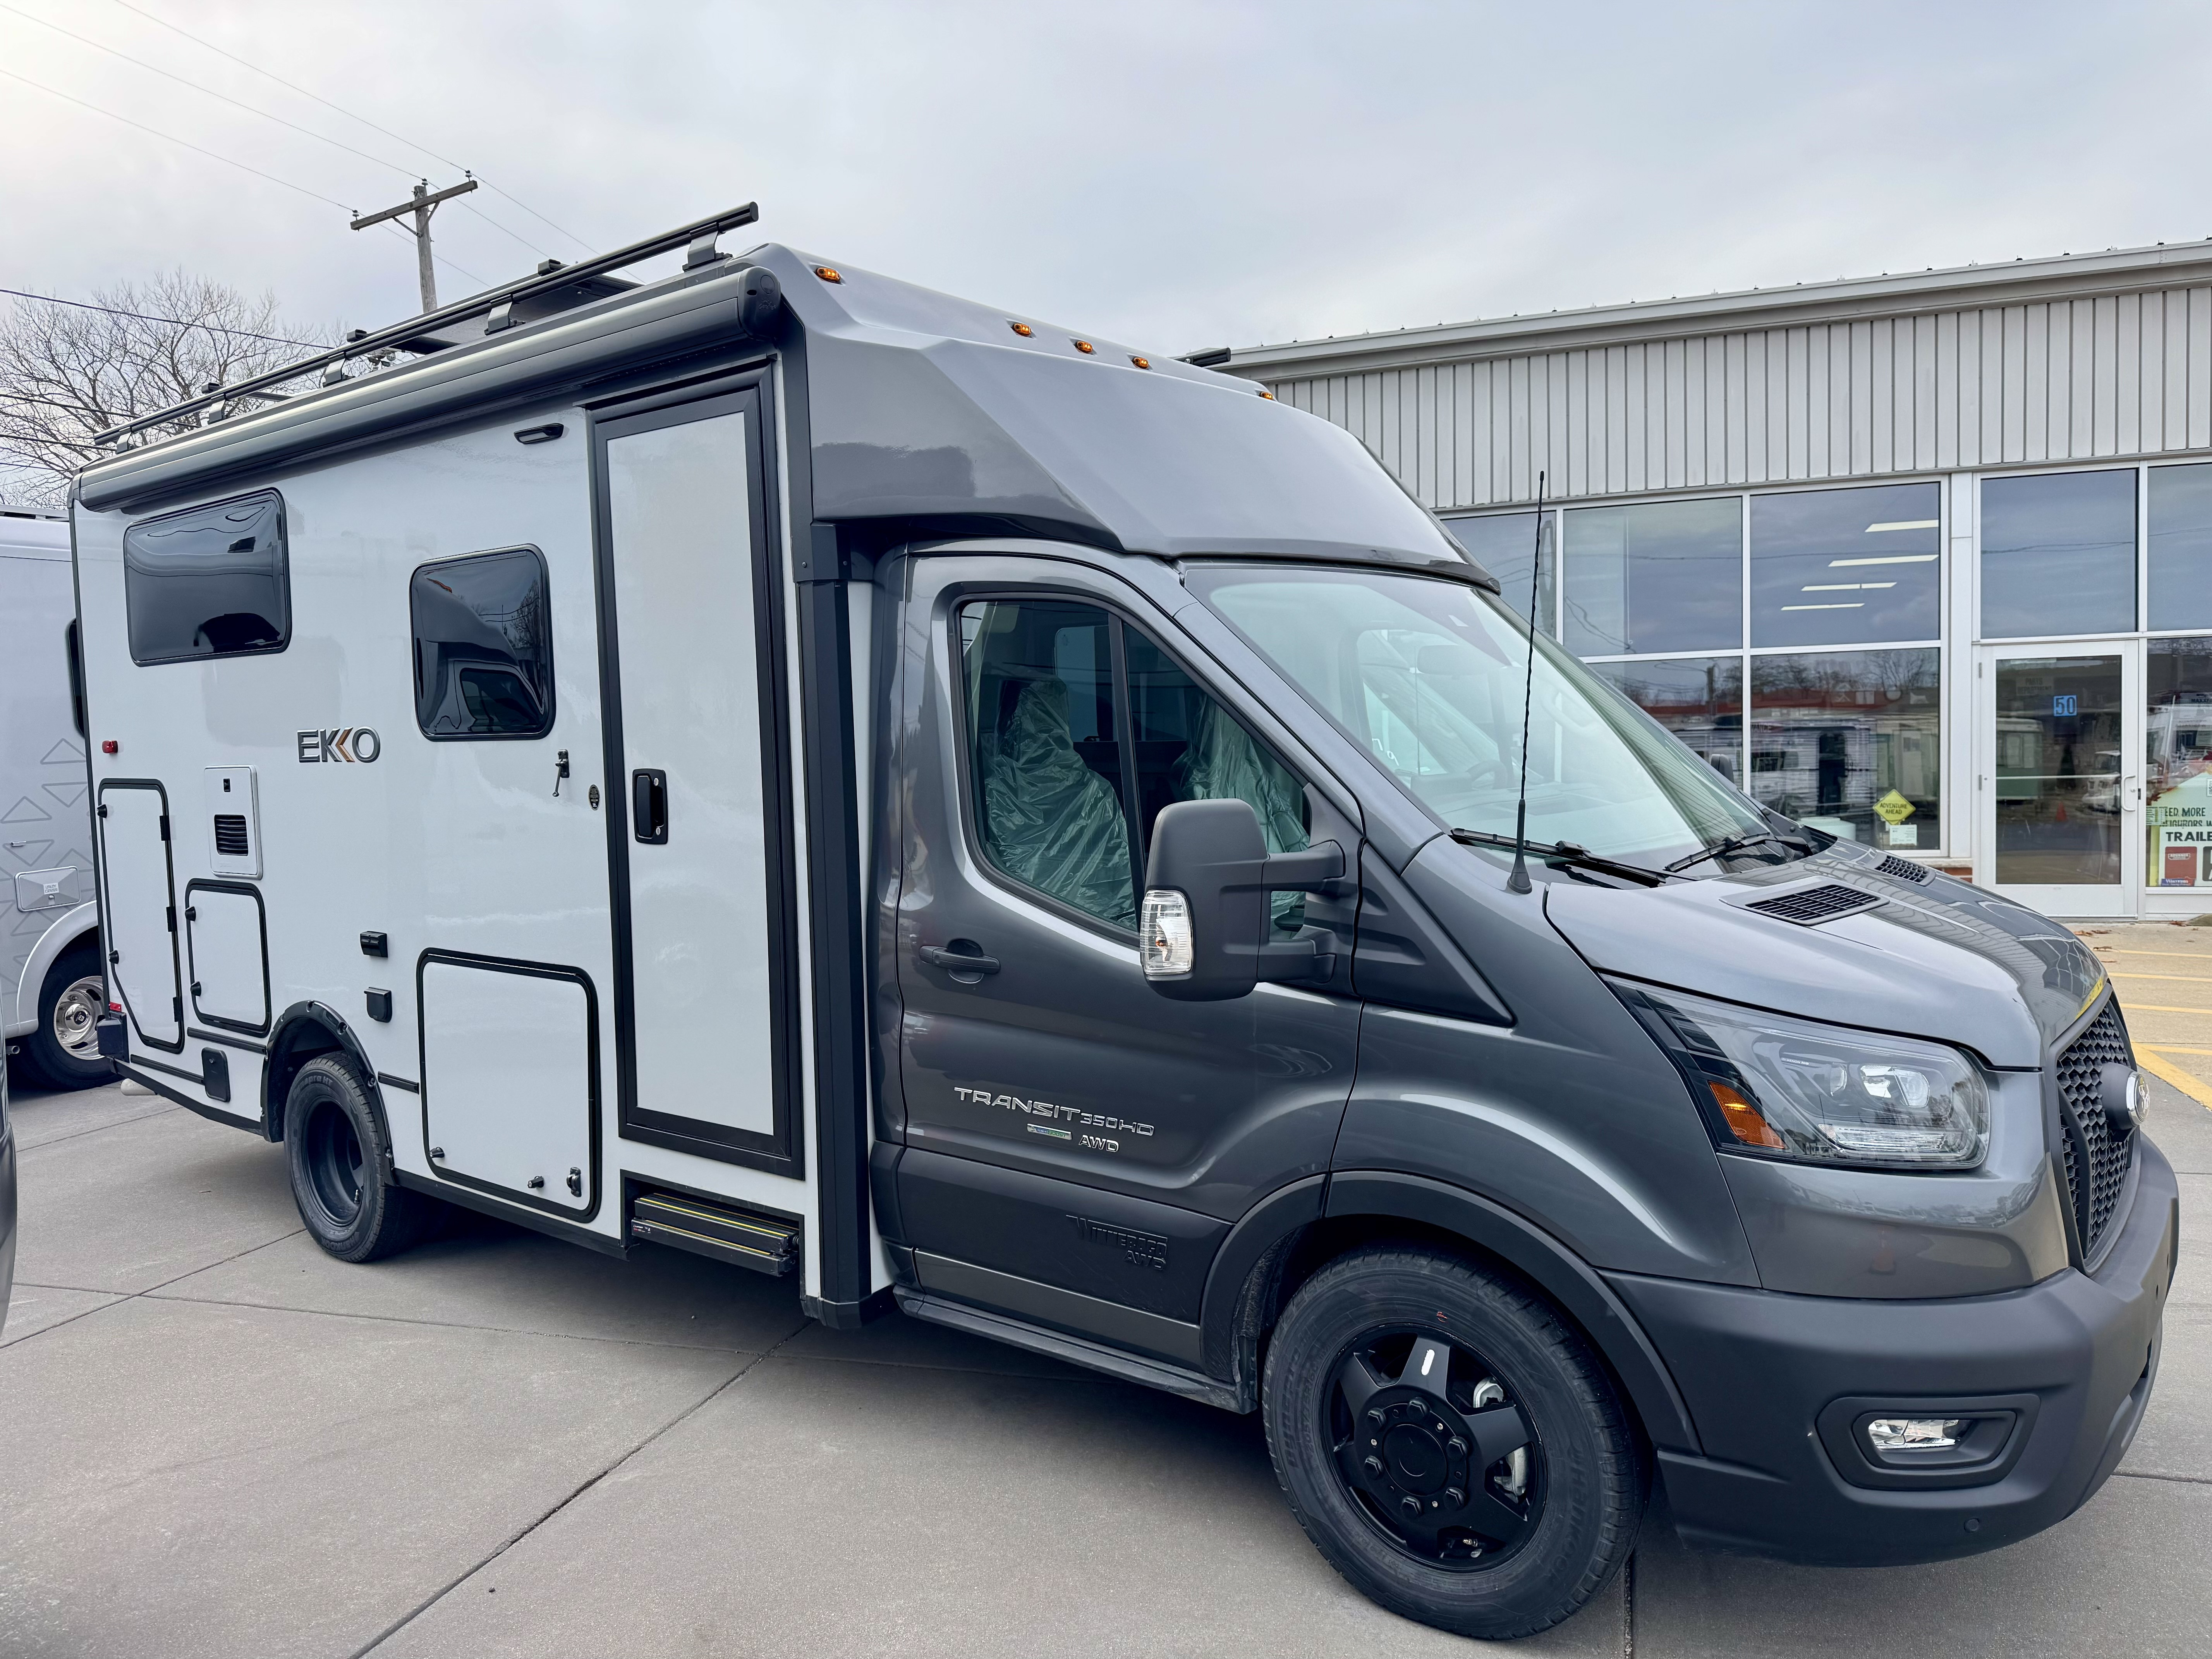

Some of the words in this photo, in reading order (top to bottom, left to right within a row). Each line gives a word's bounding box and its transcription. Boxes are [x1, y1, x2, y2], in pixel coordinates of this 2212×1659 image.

[2056, 697, 2076, 714] 50
[297, 726, 381, 763] EKKO
[2182, 807, 2205, 817] MORE
[954, 1087, 1080, 1121] TRANSIT
[1079, 1135, 1119, 1153] AWD
[1123, 1250, 1166, 1271] AWD
